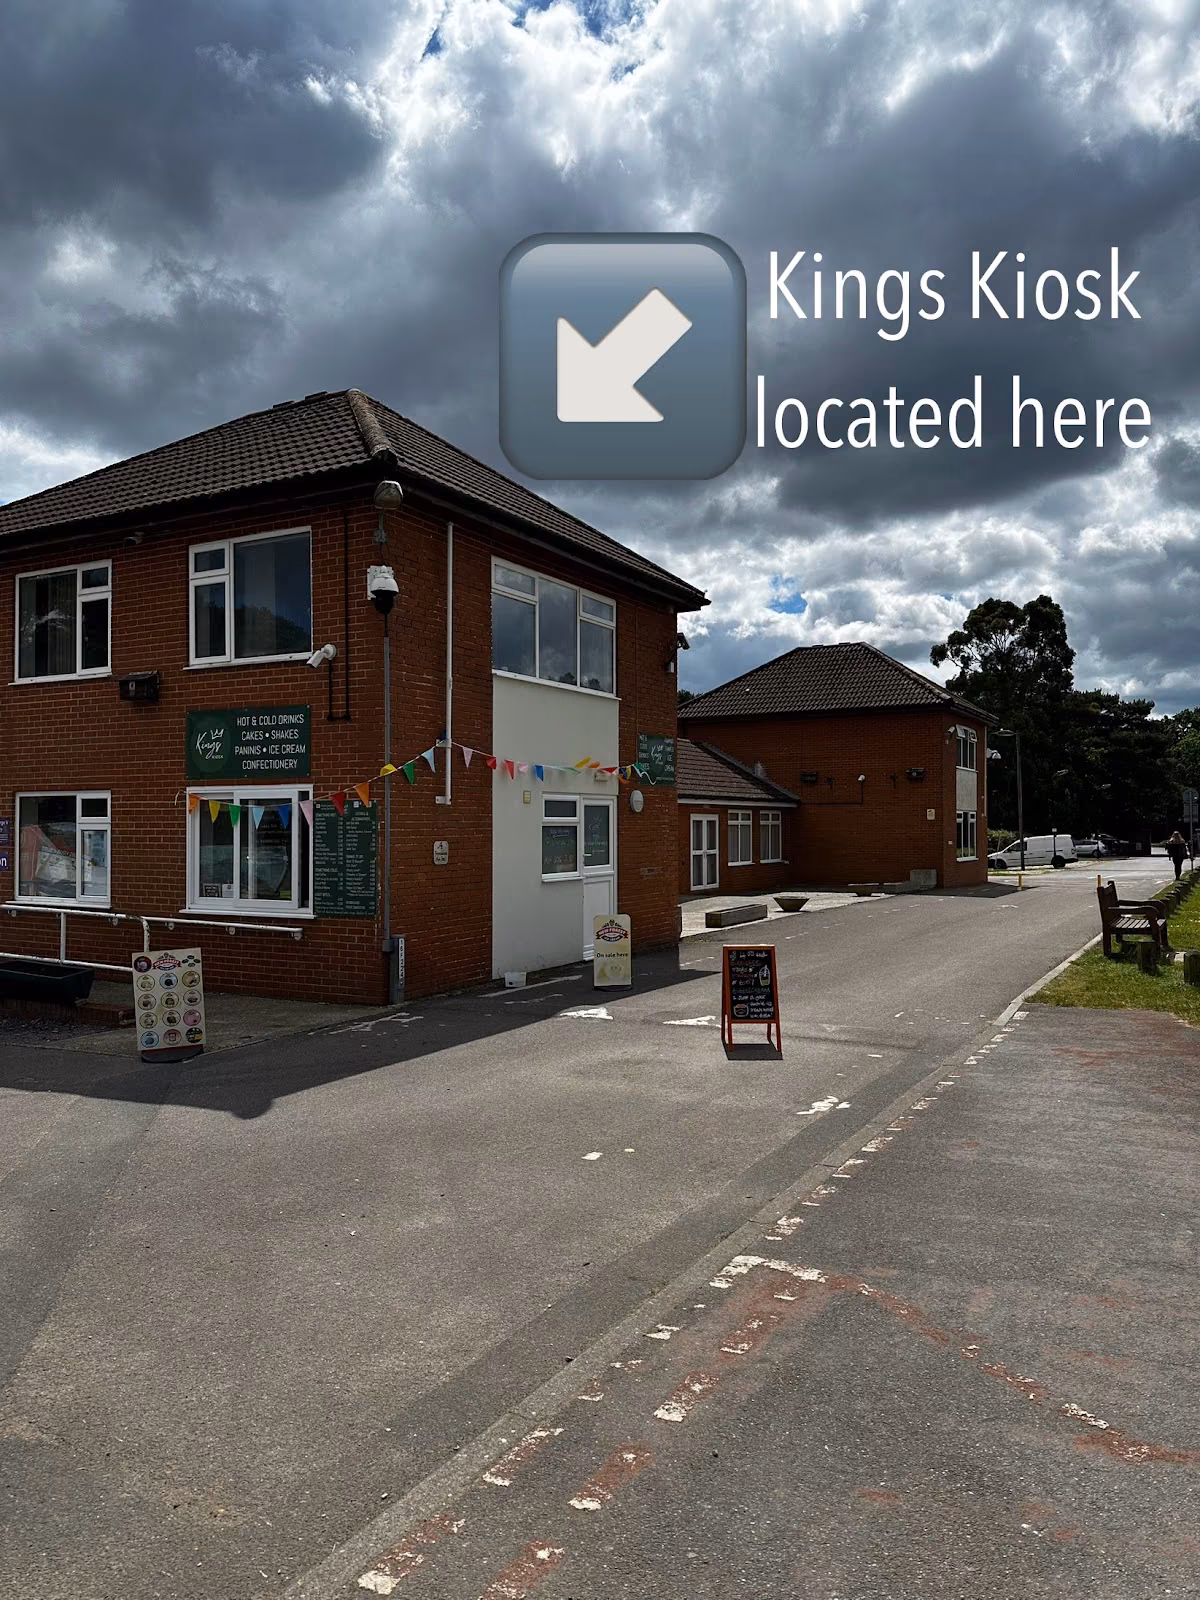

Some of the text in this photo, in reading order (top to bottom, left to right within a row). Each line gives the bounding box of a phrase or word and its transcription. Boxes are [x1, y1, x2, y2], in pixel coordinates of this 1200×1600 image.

[237, 713, 305, 727] HOT & COLD DRINKS
[241, 729, 299, 741] CAKES SHAKES
[195, 731, 223, 760] Kings
[234, 744, 306, 756] PANINIS ICE CREAM
[242, 758, 299, 770] CONFECTIONERY
